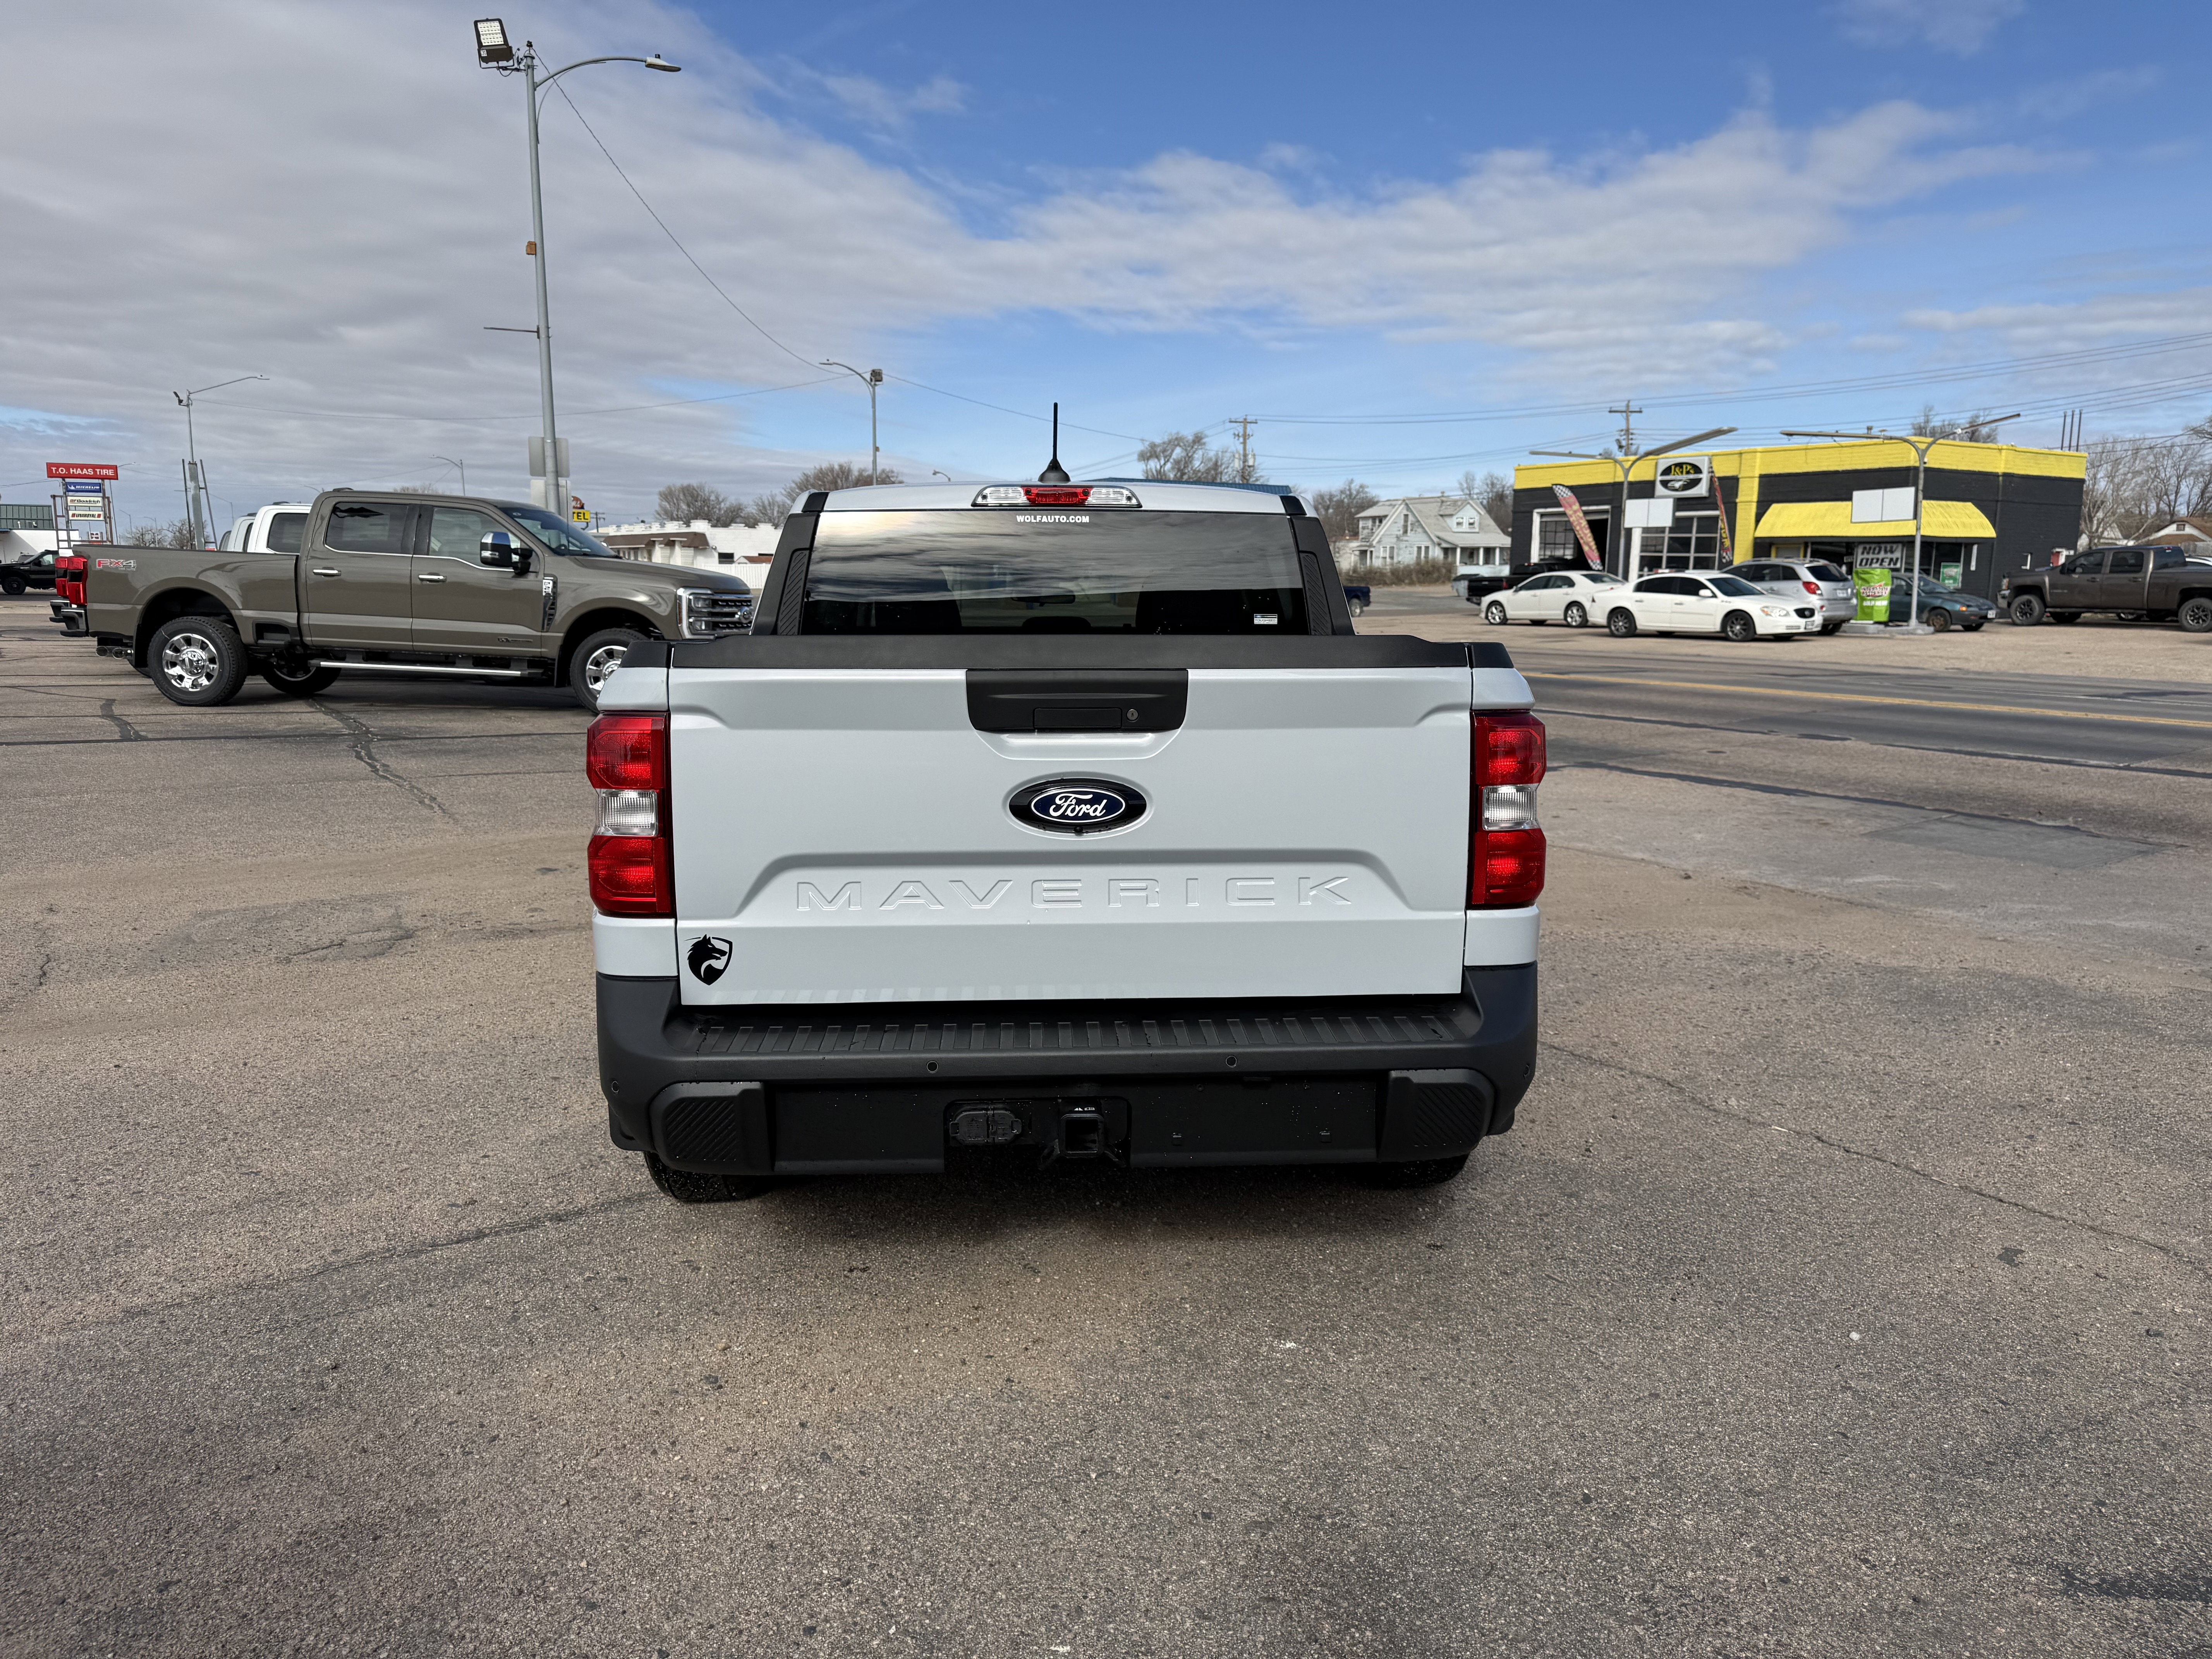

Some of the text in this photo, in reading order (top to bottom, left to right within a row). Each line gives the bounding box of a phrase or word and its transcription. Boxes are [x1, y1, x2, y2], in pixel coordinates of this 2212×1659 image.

[1861, 546, 1898, 555] NOW
[96, 559, 136, 570] FX4
[1859, 557, 1899, 566] OPEN
[1049, 793, 1107, 817] Ford
[796, 876, 1352, 911] MAVERICK
